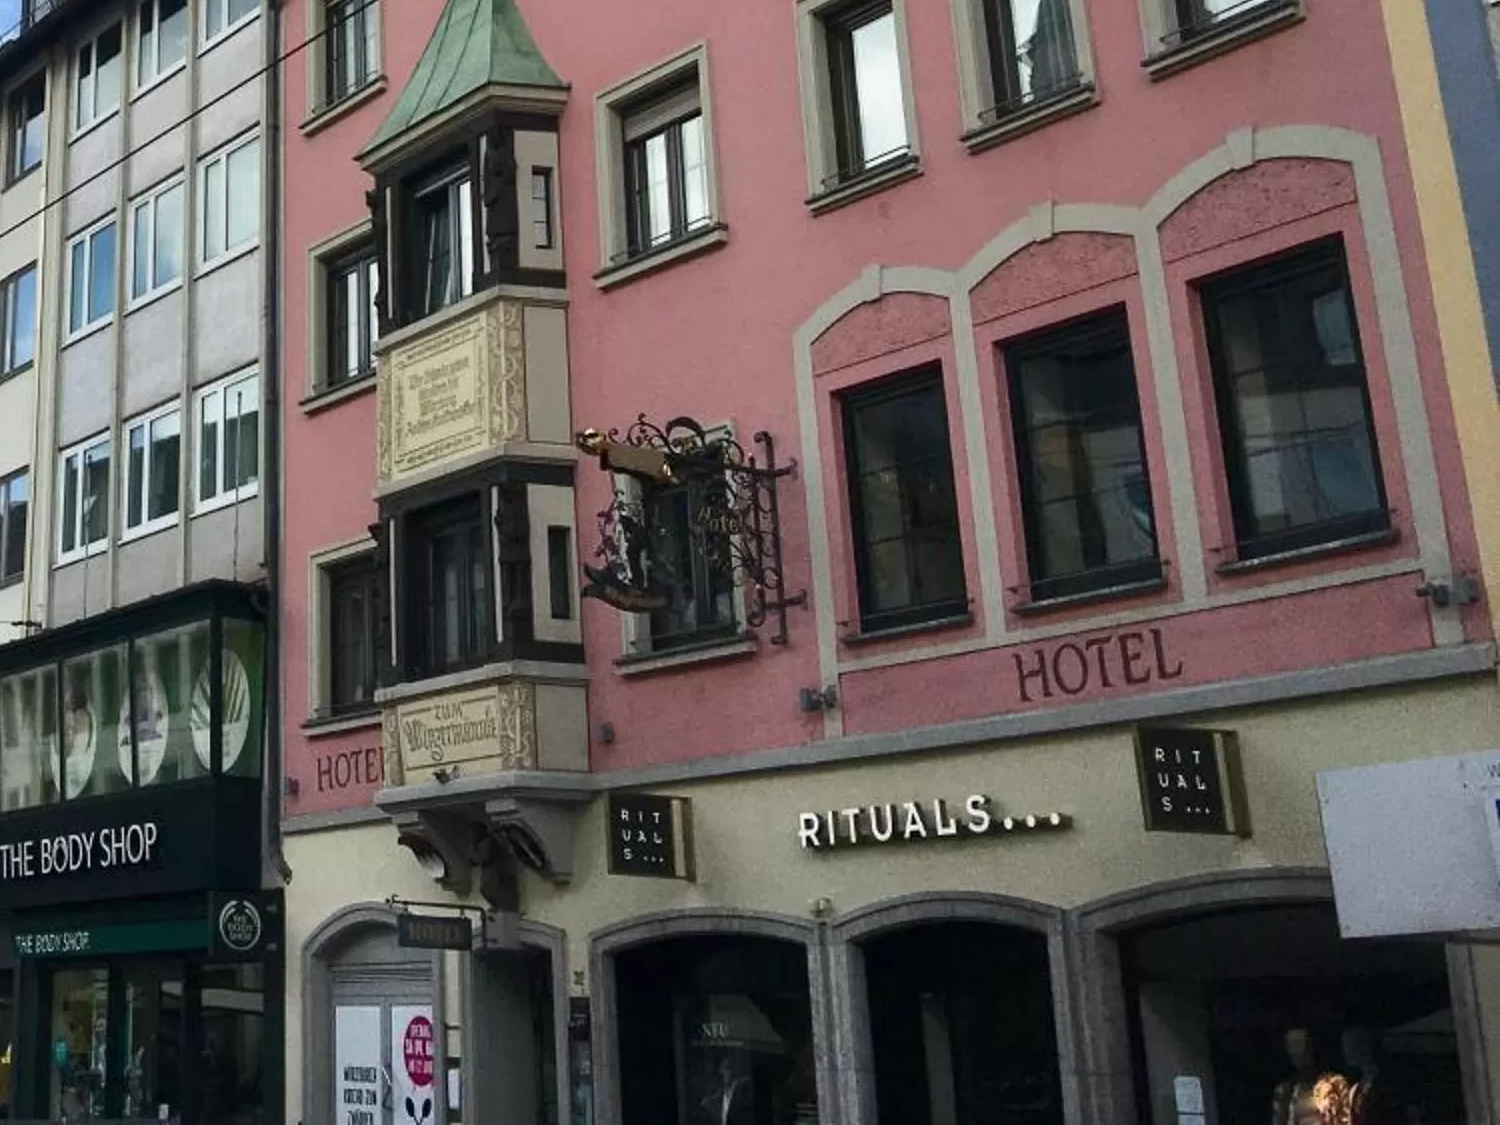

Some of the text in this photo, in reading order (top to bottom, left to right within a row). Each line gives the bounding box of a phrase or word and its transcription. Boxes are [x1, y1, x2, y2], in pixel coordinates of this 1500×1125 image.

[1011, 627, 1185, 702] HOTEL
[435, 702, 463, 721] ZUM
[0, 822, 157, 880] THE BODY SHOP
[15, 931, 90, 954] THE BODY SHOP
